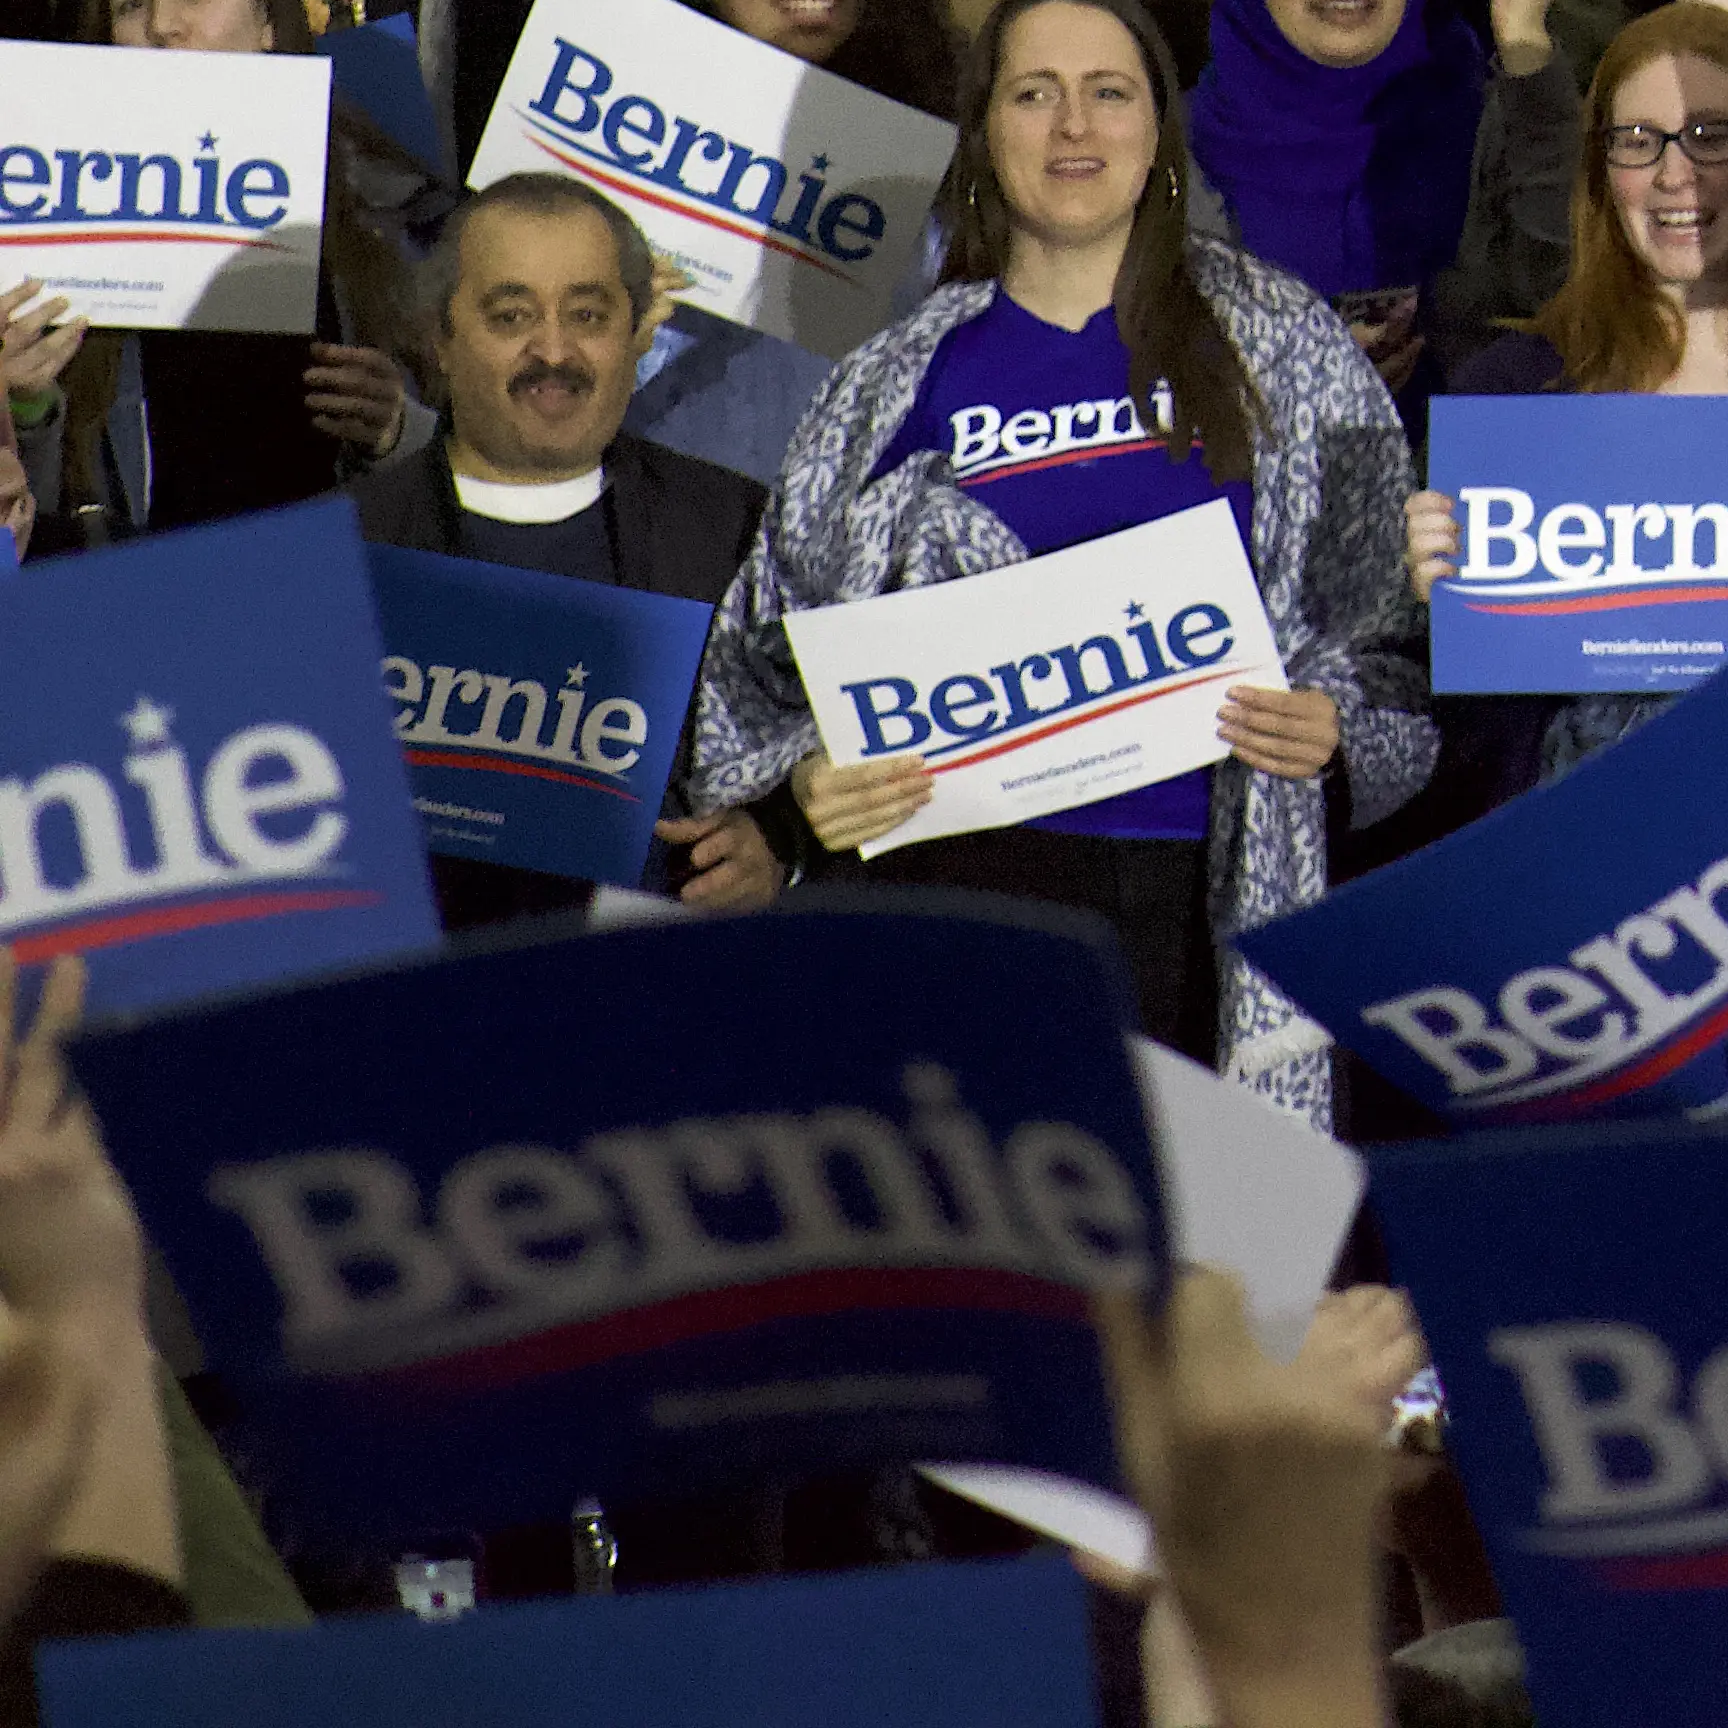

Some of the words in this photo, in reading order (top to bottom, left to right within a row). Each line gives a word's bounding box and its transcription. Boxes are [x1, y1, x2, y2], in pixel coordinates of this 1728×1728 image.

[0, 130, 290, 229] ernie
[529, 35, 887, 263] Bernie
[950, 378, 1174, 467] Berni
[380, 661, 648, 773] ernie
[841, 600, 1236, 756] Bernie
[208, 1065, 1160, 1337] Bernie
